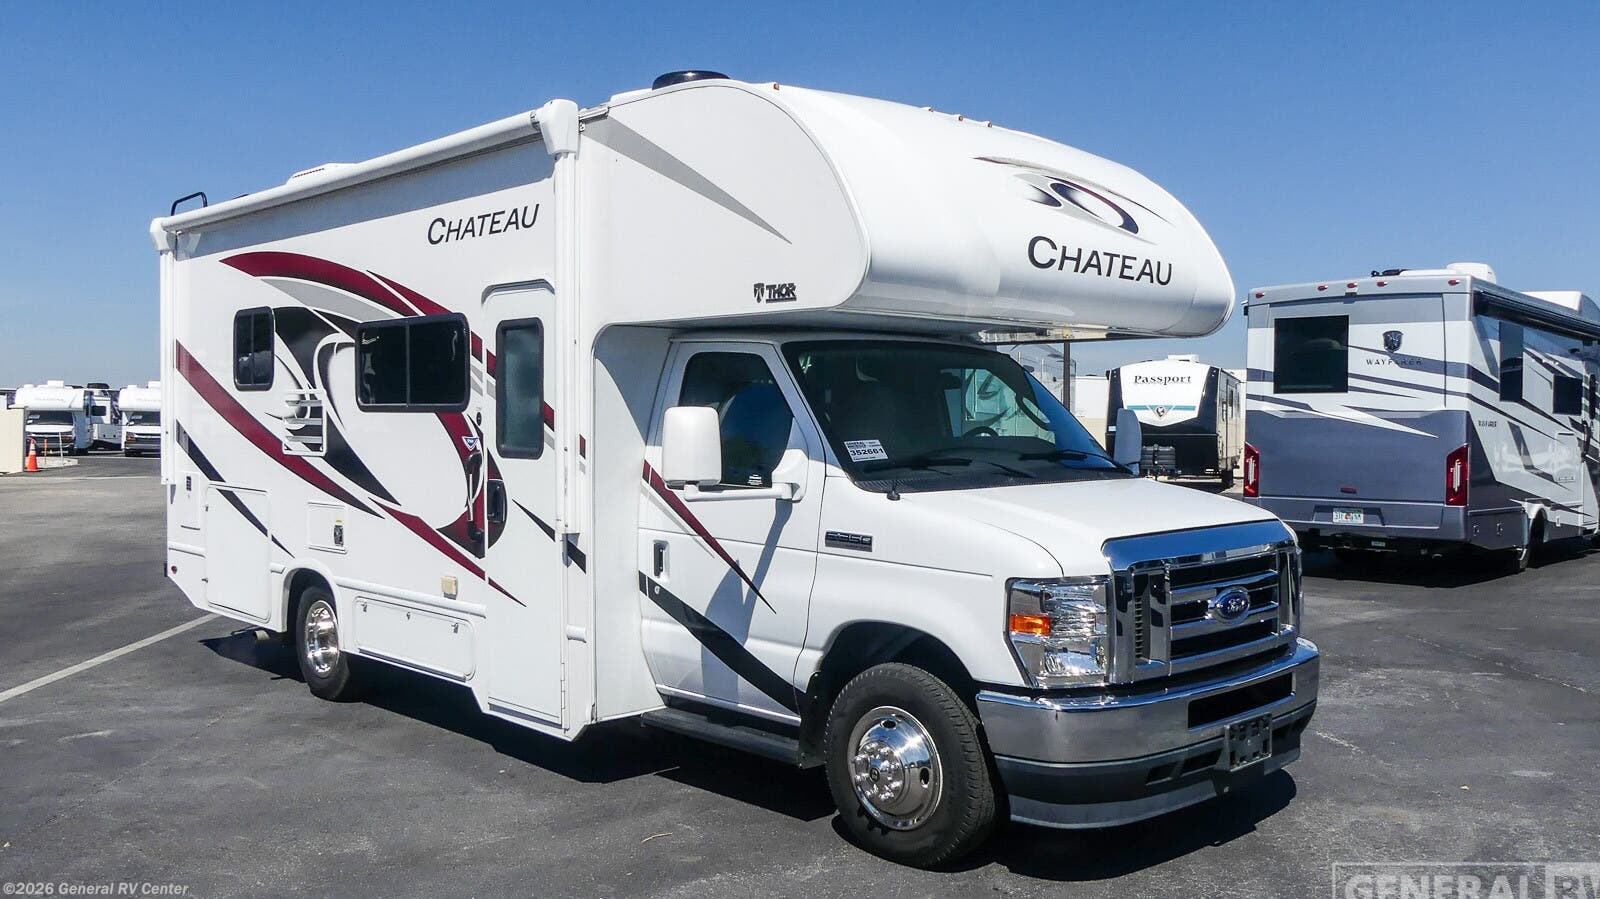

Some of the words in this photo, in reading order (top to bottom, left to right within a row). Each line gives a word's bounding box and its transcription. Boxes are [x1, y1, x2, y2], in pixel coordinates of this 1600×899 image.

[428, 204, 539, 245] CHATEAU
[1028, 235, 1172, 286] CHATEAU
[766, 283, 796, 299] THOR
[1134, 375, 1192, 386] Passport
